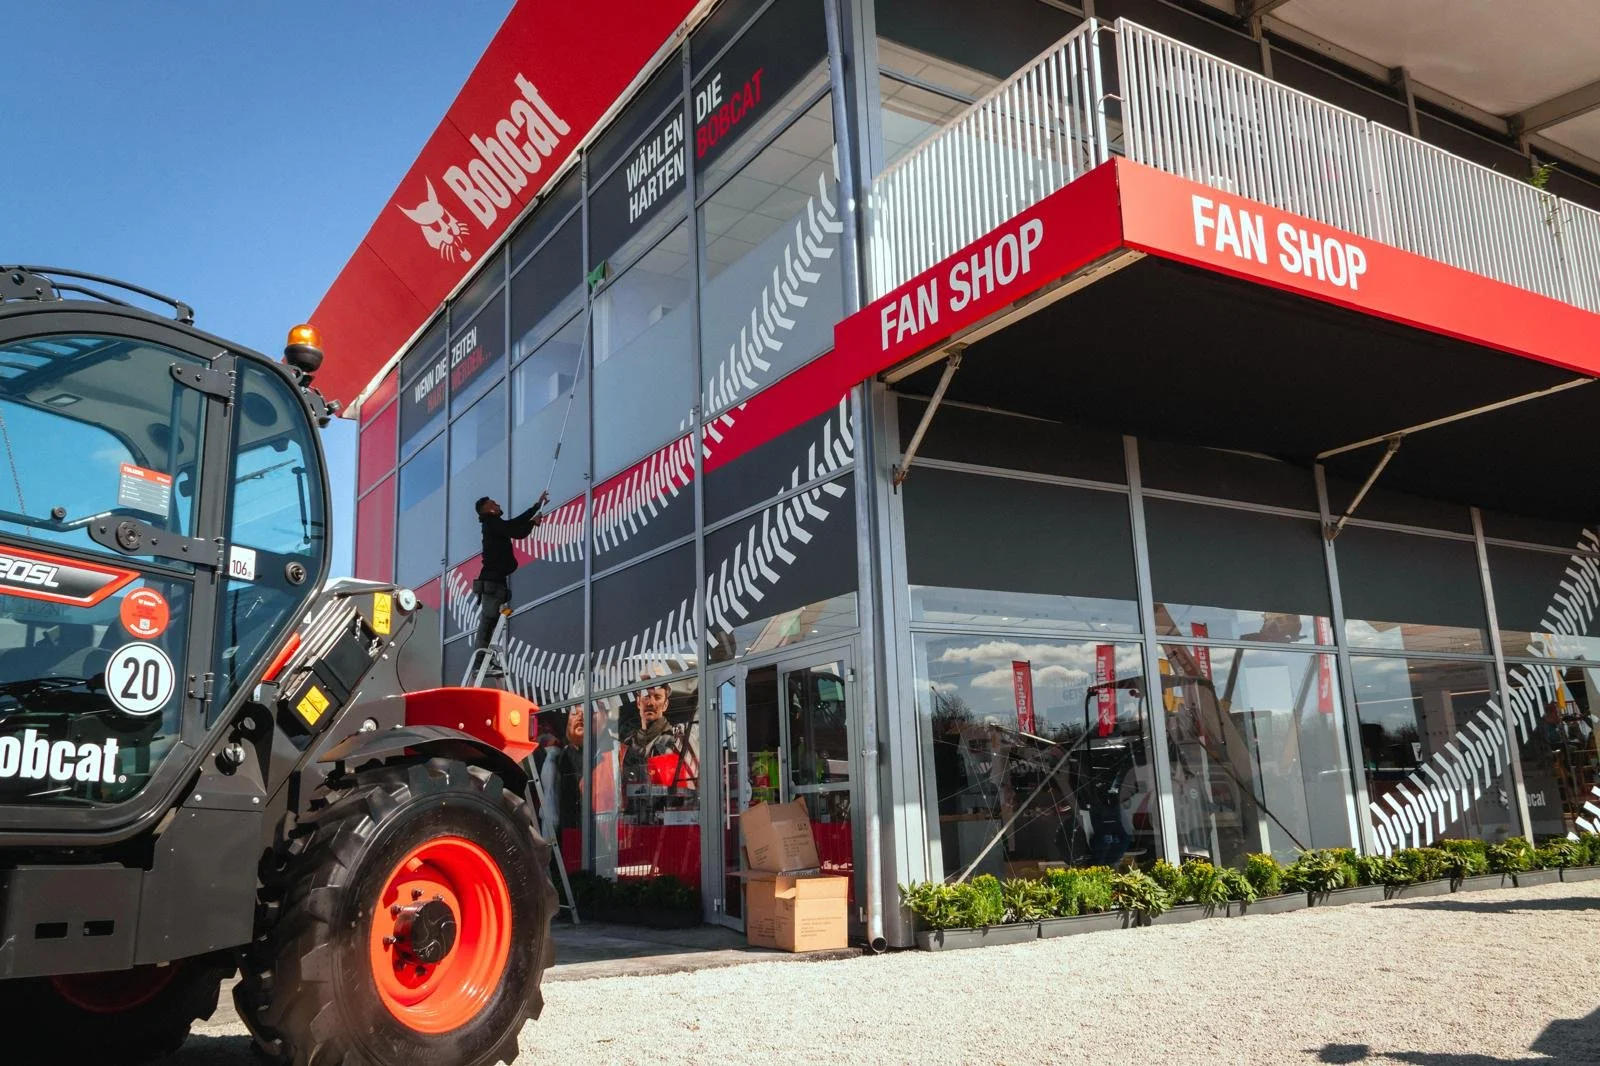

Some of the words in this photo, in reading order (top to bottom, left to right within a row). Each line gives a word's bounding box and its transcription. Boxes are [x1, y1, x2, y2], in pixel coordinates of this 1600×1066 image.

[442, 72, 571, 230] Bobcat
[626, 112, 683, 193] WÄHLEN
[696, 72, 722, 125] DIE
[629, 146, 684, 224] HARTEN
[696, 67, 764, 160] BOBCAT
[880, 287, 939, 351] FAN
[949, 218, 1044, 312] SHOP
[1192, 194, 1268, 264] FAN
[1276, 222, 1367, 291] SHOP
[415, 369, 435, 404] WENN
[435, 356, 447, 385] DIE
[451, 326, 477, 369] ZEITEN
[232, 559, 247, 576] 106
[121, 657, 160, 701] 20
